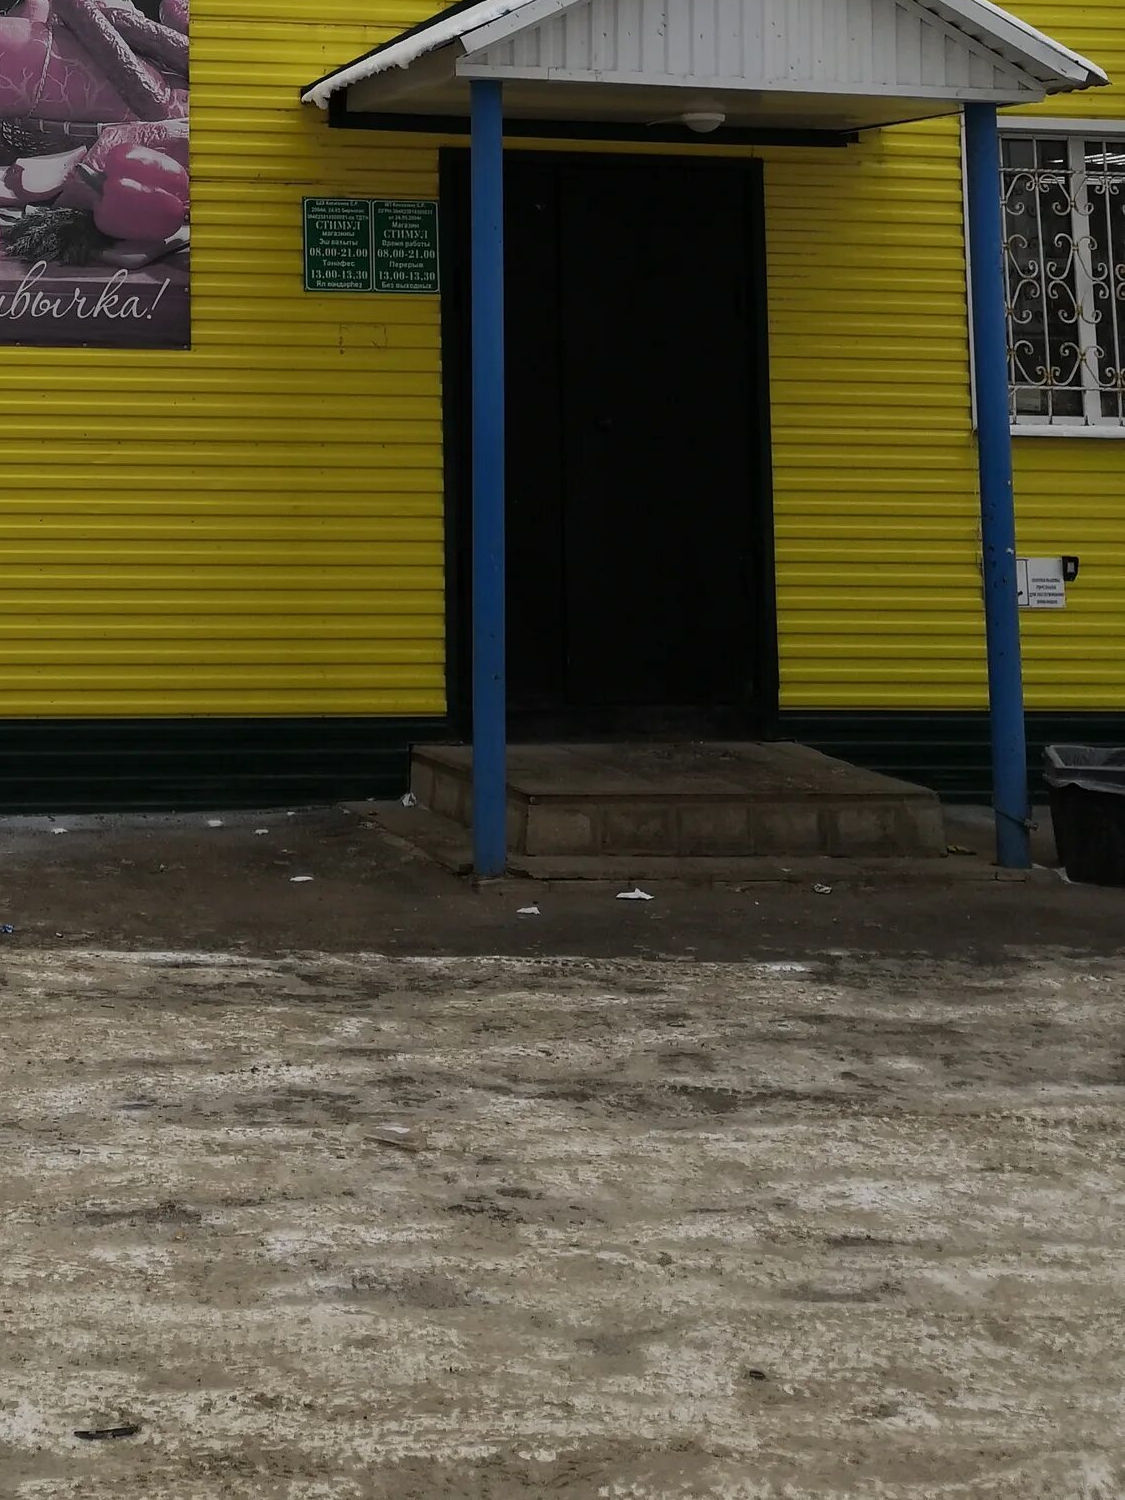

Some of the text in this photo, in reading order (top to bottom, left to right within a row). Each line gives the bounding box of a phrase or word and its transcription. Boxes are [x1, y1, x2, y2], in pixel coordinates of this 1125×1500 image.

[315, 220, 361, 231] СТИМУЛ
[383, 230, 428, 239] СТИМУЛ
[309, 248, 368, 258] 08.00-21.00
[377, 249, 436, 259] 08.00-21.00
[311, 269, 368, 280] 13.00-13.30
[379, 270, 436, 281] 13.00-13.30
